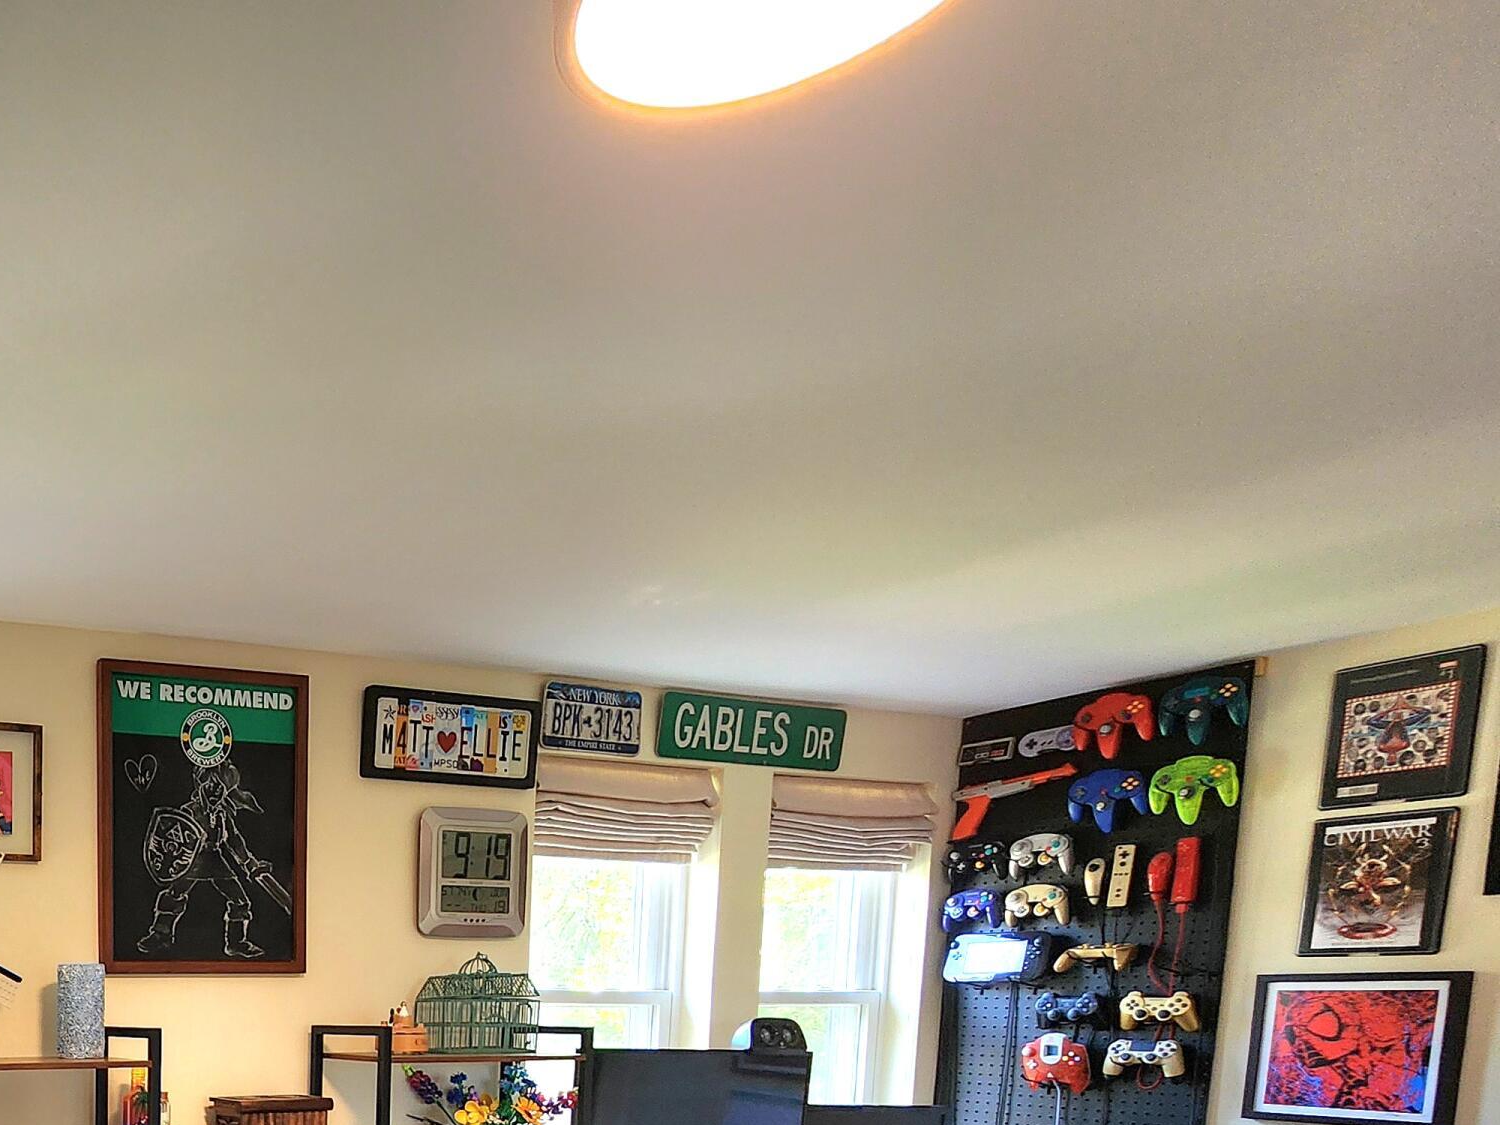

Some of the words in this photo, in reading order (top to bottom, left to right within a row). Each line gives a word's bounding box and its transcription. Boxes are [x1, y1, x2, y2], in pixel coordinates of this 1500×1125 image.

[116, 679, 151, 700] WE
[159, 683, 294, 711] RECOMMEND
[569, 687, 592, 703] NEW
[593, 690, 620, 706] YORK
[186, 710, 227, 729] BROOKLYN
[674, 702, 791, 757] GABLES
[802, 725, 834, 760] DR
[458, 724, 524, 762] ELLIE
[186, 748, 225, 766] BREWERY
[1324, 828, 1382, 847] CIVIL
[1382, 824, 1434, 843] WAR
[452, 831, 510, 880] 9:19
